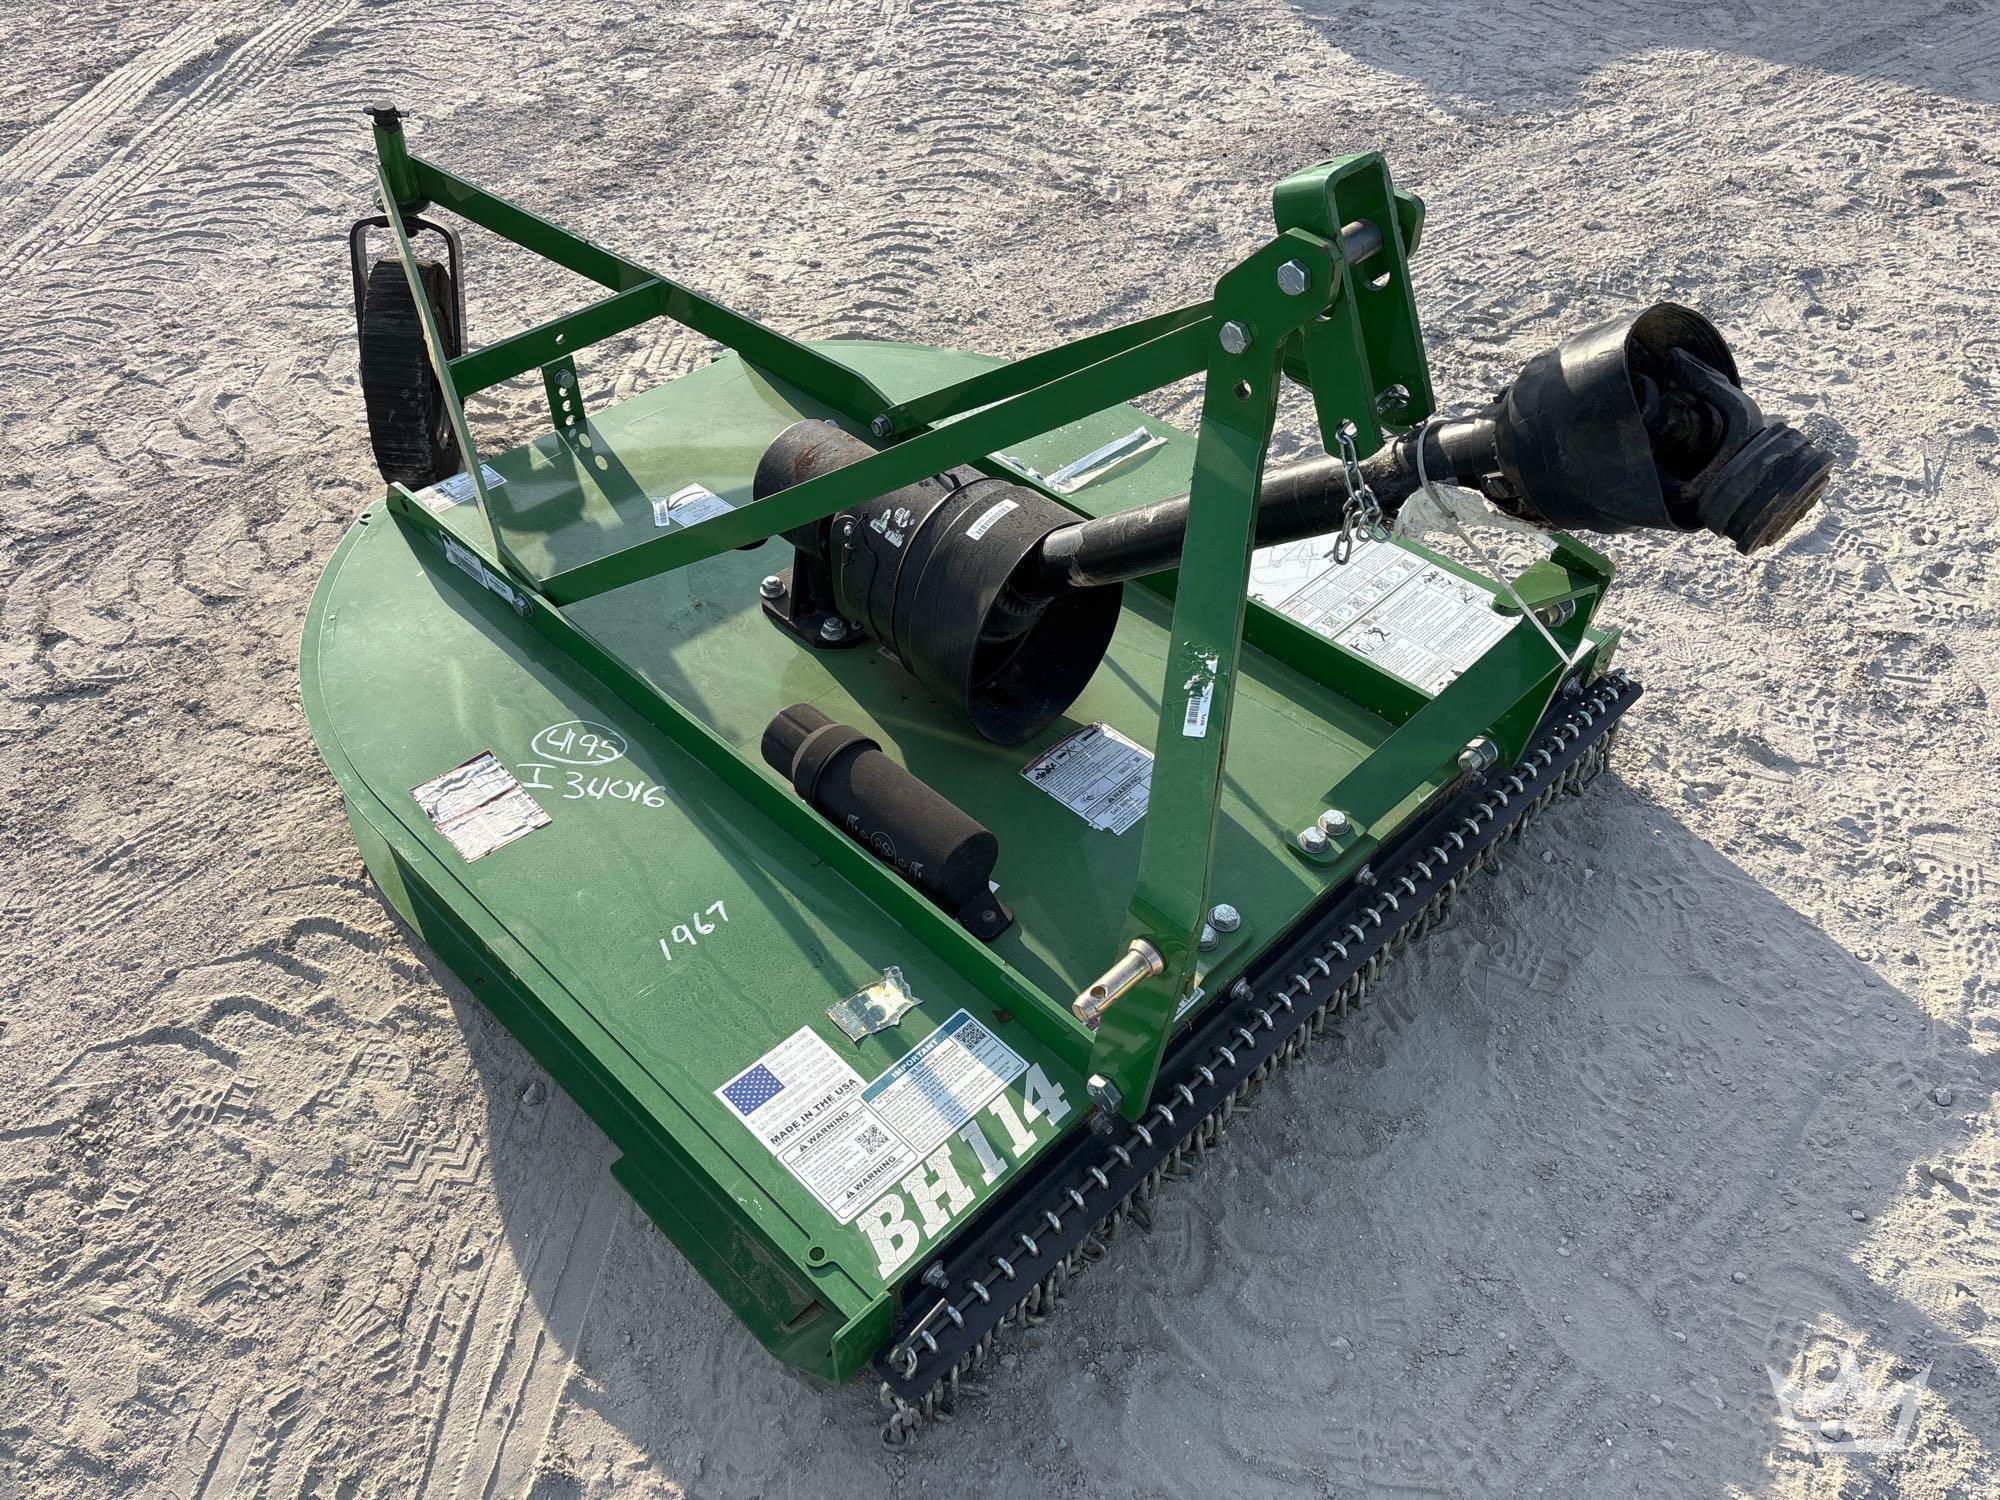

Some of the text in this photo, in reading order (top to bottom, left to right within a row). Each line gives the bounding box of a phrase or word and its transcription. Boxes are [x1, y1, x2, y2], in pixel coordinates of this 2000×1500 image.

[546, 728, 620, 760] 4195
[562, 771, 666, 808] 34016
[658, 900, 729, 961] 1967
[890, 1037, 938, 1078] IMPORTANT
[769, 1076, 857, 1145] MADE IN THE USA
[813, 1095, 842, 1118] IMPORTED
[806, 1109, 850, 1145] WARNING
[853, 1154, 896, 1191] WARNING
[856, 1062, 1072, 1280] BH114
